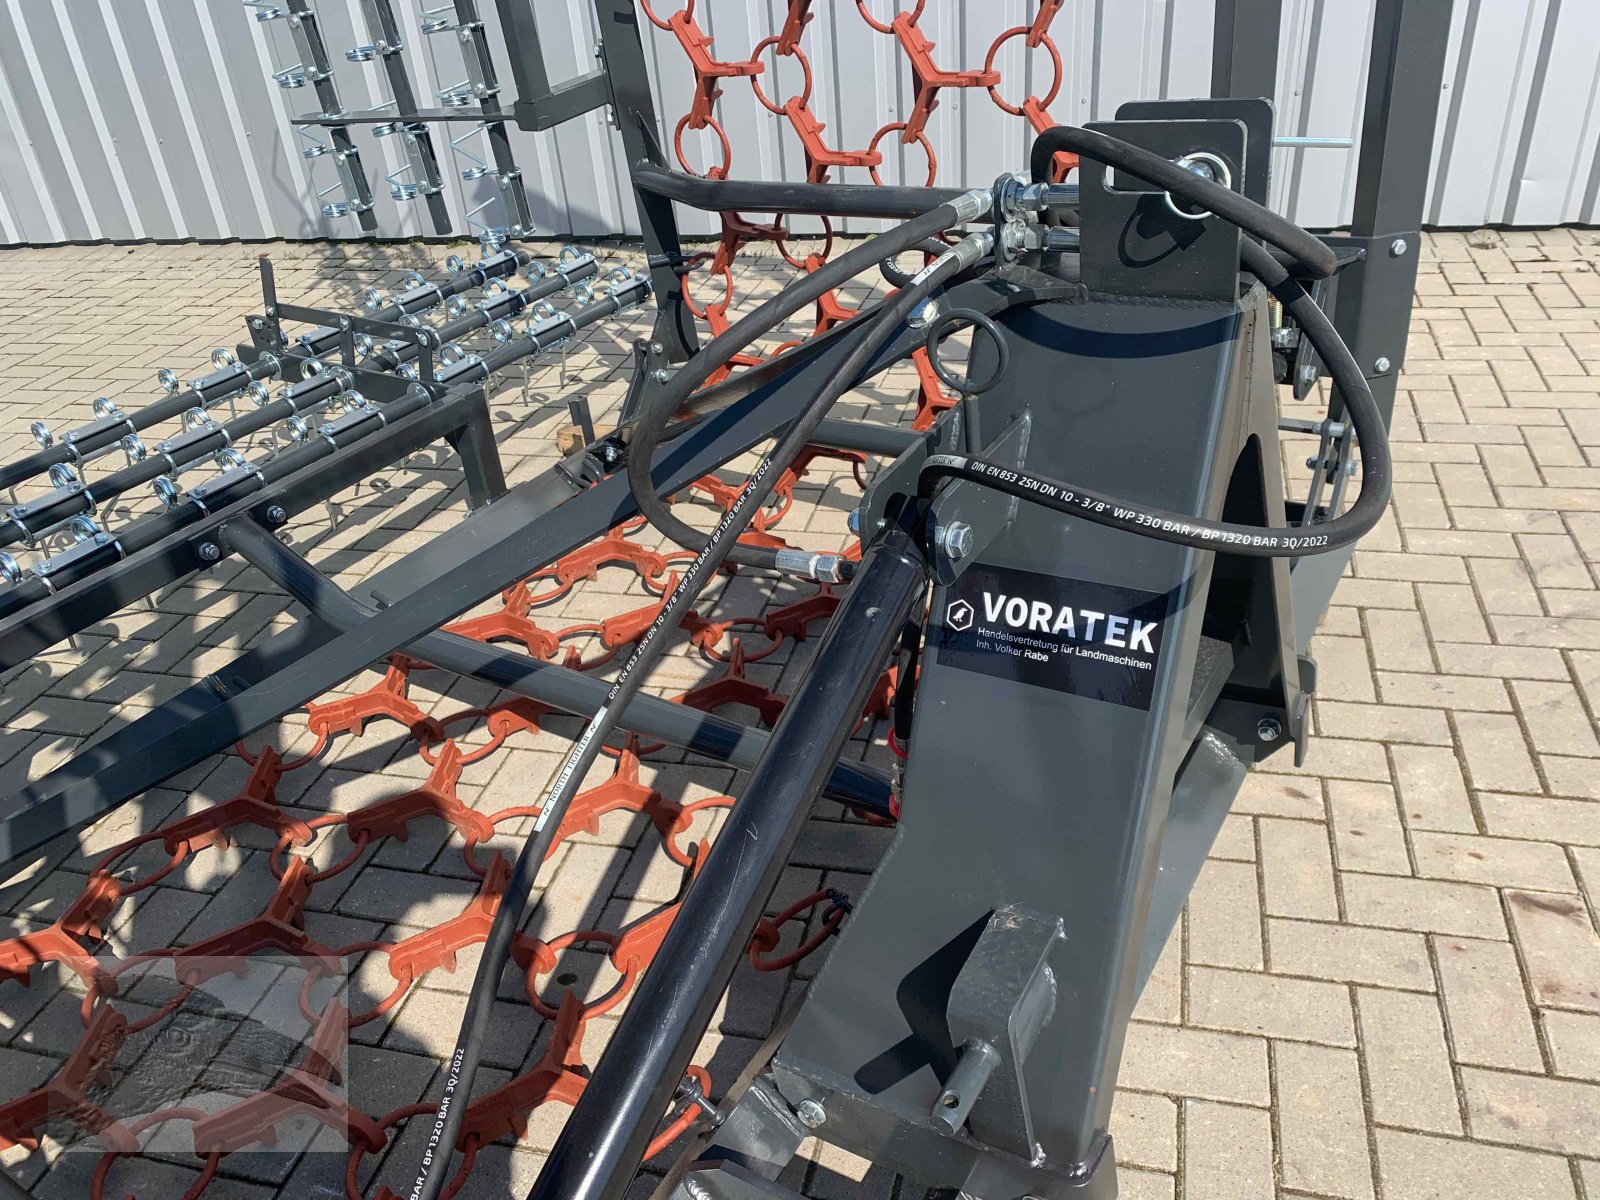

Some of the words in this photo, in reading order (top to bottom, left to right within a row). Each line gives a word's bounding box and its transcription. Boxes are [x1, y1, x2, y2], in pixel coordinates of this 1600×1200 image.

[971, 461, 986, 472] DIN
[986, 466, 1001, 477] EN
[999, 470, 1018, 483] 853
[1018, 476, 1041, 491] 2SN
[1039, 484, 1058, 497] DN
[1060, 490, 1074, 502] 10
[1080, 497, 1111, 512] 3/8"
[1113, 507, 1136, 520] WP
[1135, 514, 1161, 528] 330
[1162, 520, 1191, 535] BAR
[1201, 529, 1221, 542] BP
[1221, 532, 1252, 545] 1320
[1252, 536, 1278, 548] BAR
[1281, 535, 1329, 550] 3Q/2022
[608, 683, 620, 700] DIN
[618, 669, 628, 683] EN
[626, 655, 638, 672] 853
[647, 625, 657, 639] DN
[656, 615, 665, 626] 10
[665, 592, 677, 613] 3/8"
[677, 578, 689, 593] WP
[688, 563, 699, 581] 330
[697, 547, 711, 565] BAR
[712, 530, 721, 543] BP
[720, 512, 735, 532] 1320
[733, 494, 747, 513] BAR
[745, 458, 772, 495] 3Q/2022
[976, 639, 992, 650] Inh.
[994, 643, 1022, 657] Volker
[1024, 648, 1049, 662] Rabe
[978, 626, 1059, 652] Handelsvertretung
[1060, 642, 1075, 654] für
[1075, 645, 1152, 671] Landmaschinen
[983, 591, 1158, 654] VORATEK
[549, 772, 569, 802] NORTH
[410, 1176, 425, 1200] BAR
[422, 1148, 433, 1166] BP
[428, 1120, 444, 1147] 1320
[437, 1096, 452, 1119] BAR
[445, 1048, 465, 1093] 3Q/2022
